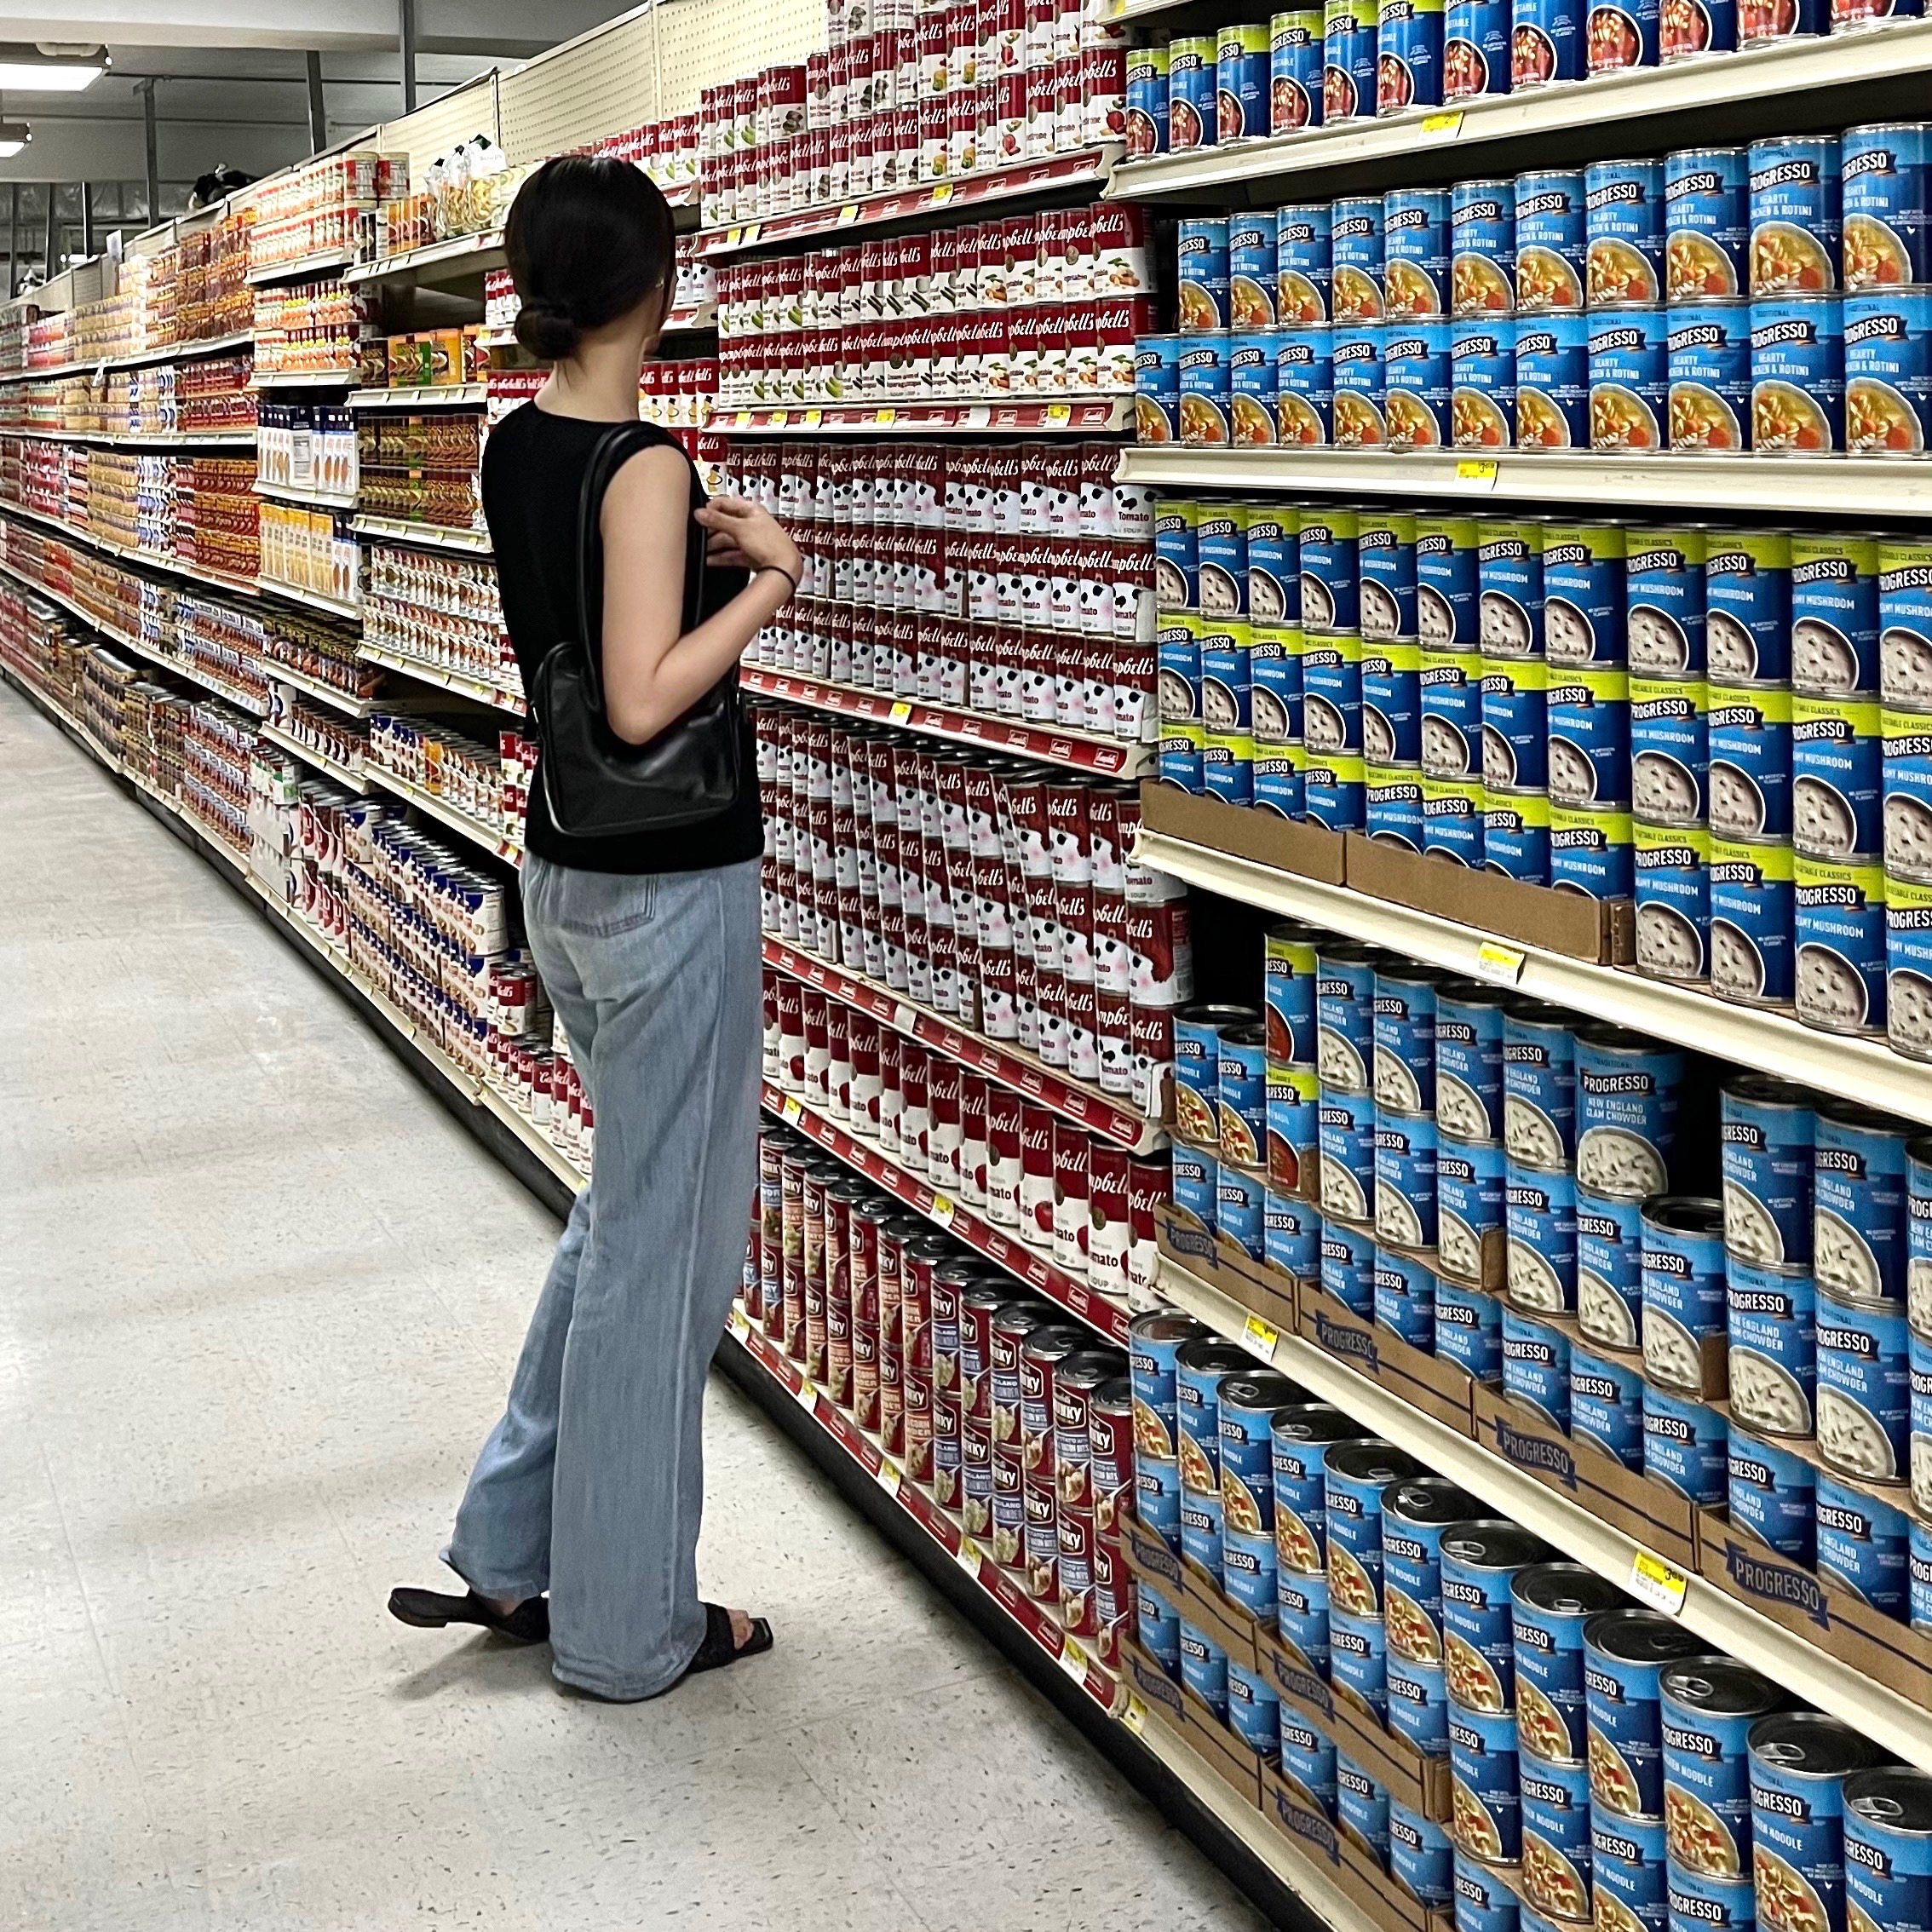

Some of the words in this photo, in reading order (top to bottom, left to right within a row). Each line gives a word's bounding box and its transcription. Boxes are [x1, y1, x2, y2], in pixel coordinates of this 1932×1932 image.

[1781, 205, 1812, 216] ROTINI
[1118, 511, 1149, 522] Tomato
[1627, 553, 1676, 572] ROGRESSO
[1793, 561, 1847, 582] ROGRESSO
[1793, 721, 1845, 740] ROGRESSO
[1423, 800, 1468, 815] ROGRESSO
[1551, 831, 1599, 848] ROGRESSO
[1653, 880, 1698, 895] MUSHROOM
[1813, 919, 1863, 939] MUSHROOM
[1584, 1075, 1648, 1091] PROGRESSO
[1588, 1097, 1605, 1108] NEW
[1607, 1099, 1643, 1113] ENGLAND
[1586, 1108, 1603, 1119] CLAM
[1607, 1111, 1646, 1124] CHOWDER
[1322, 1325, 1373, 1357] PROGRESSO
[1502, 1432, 1568, 1473] PROGRESSO
[1736, 1555, 1819, 1611] PROGRESSO
